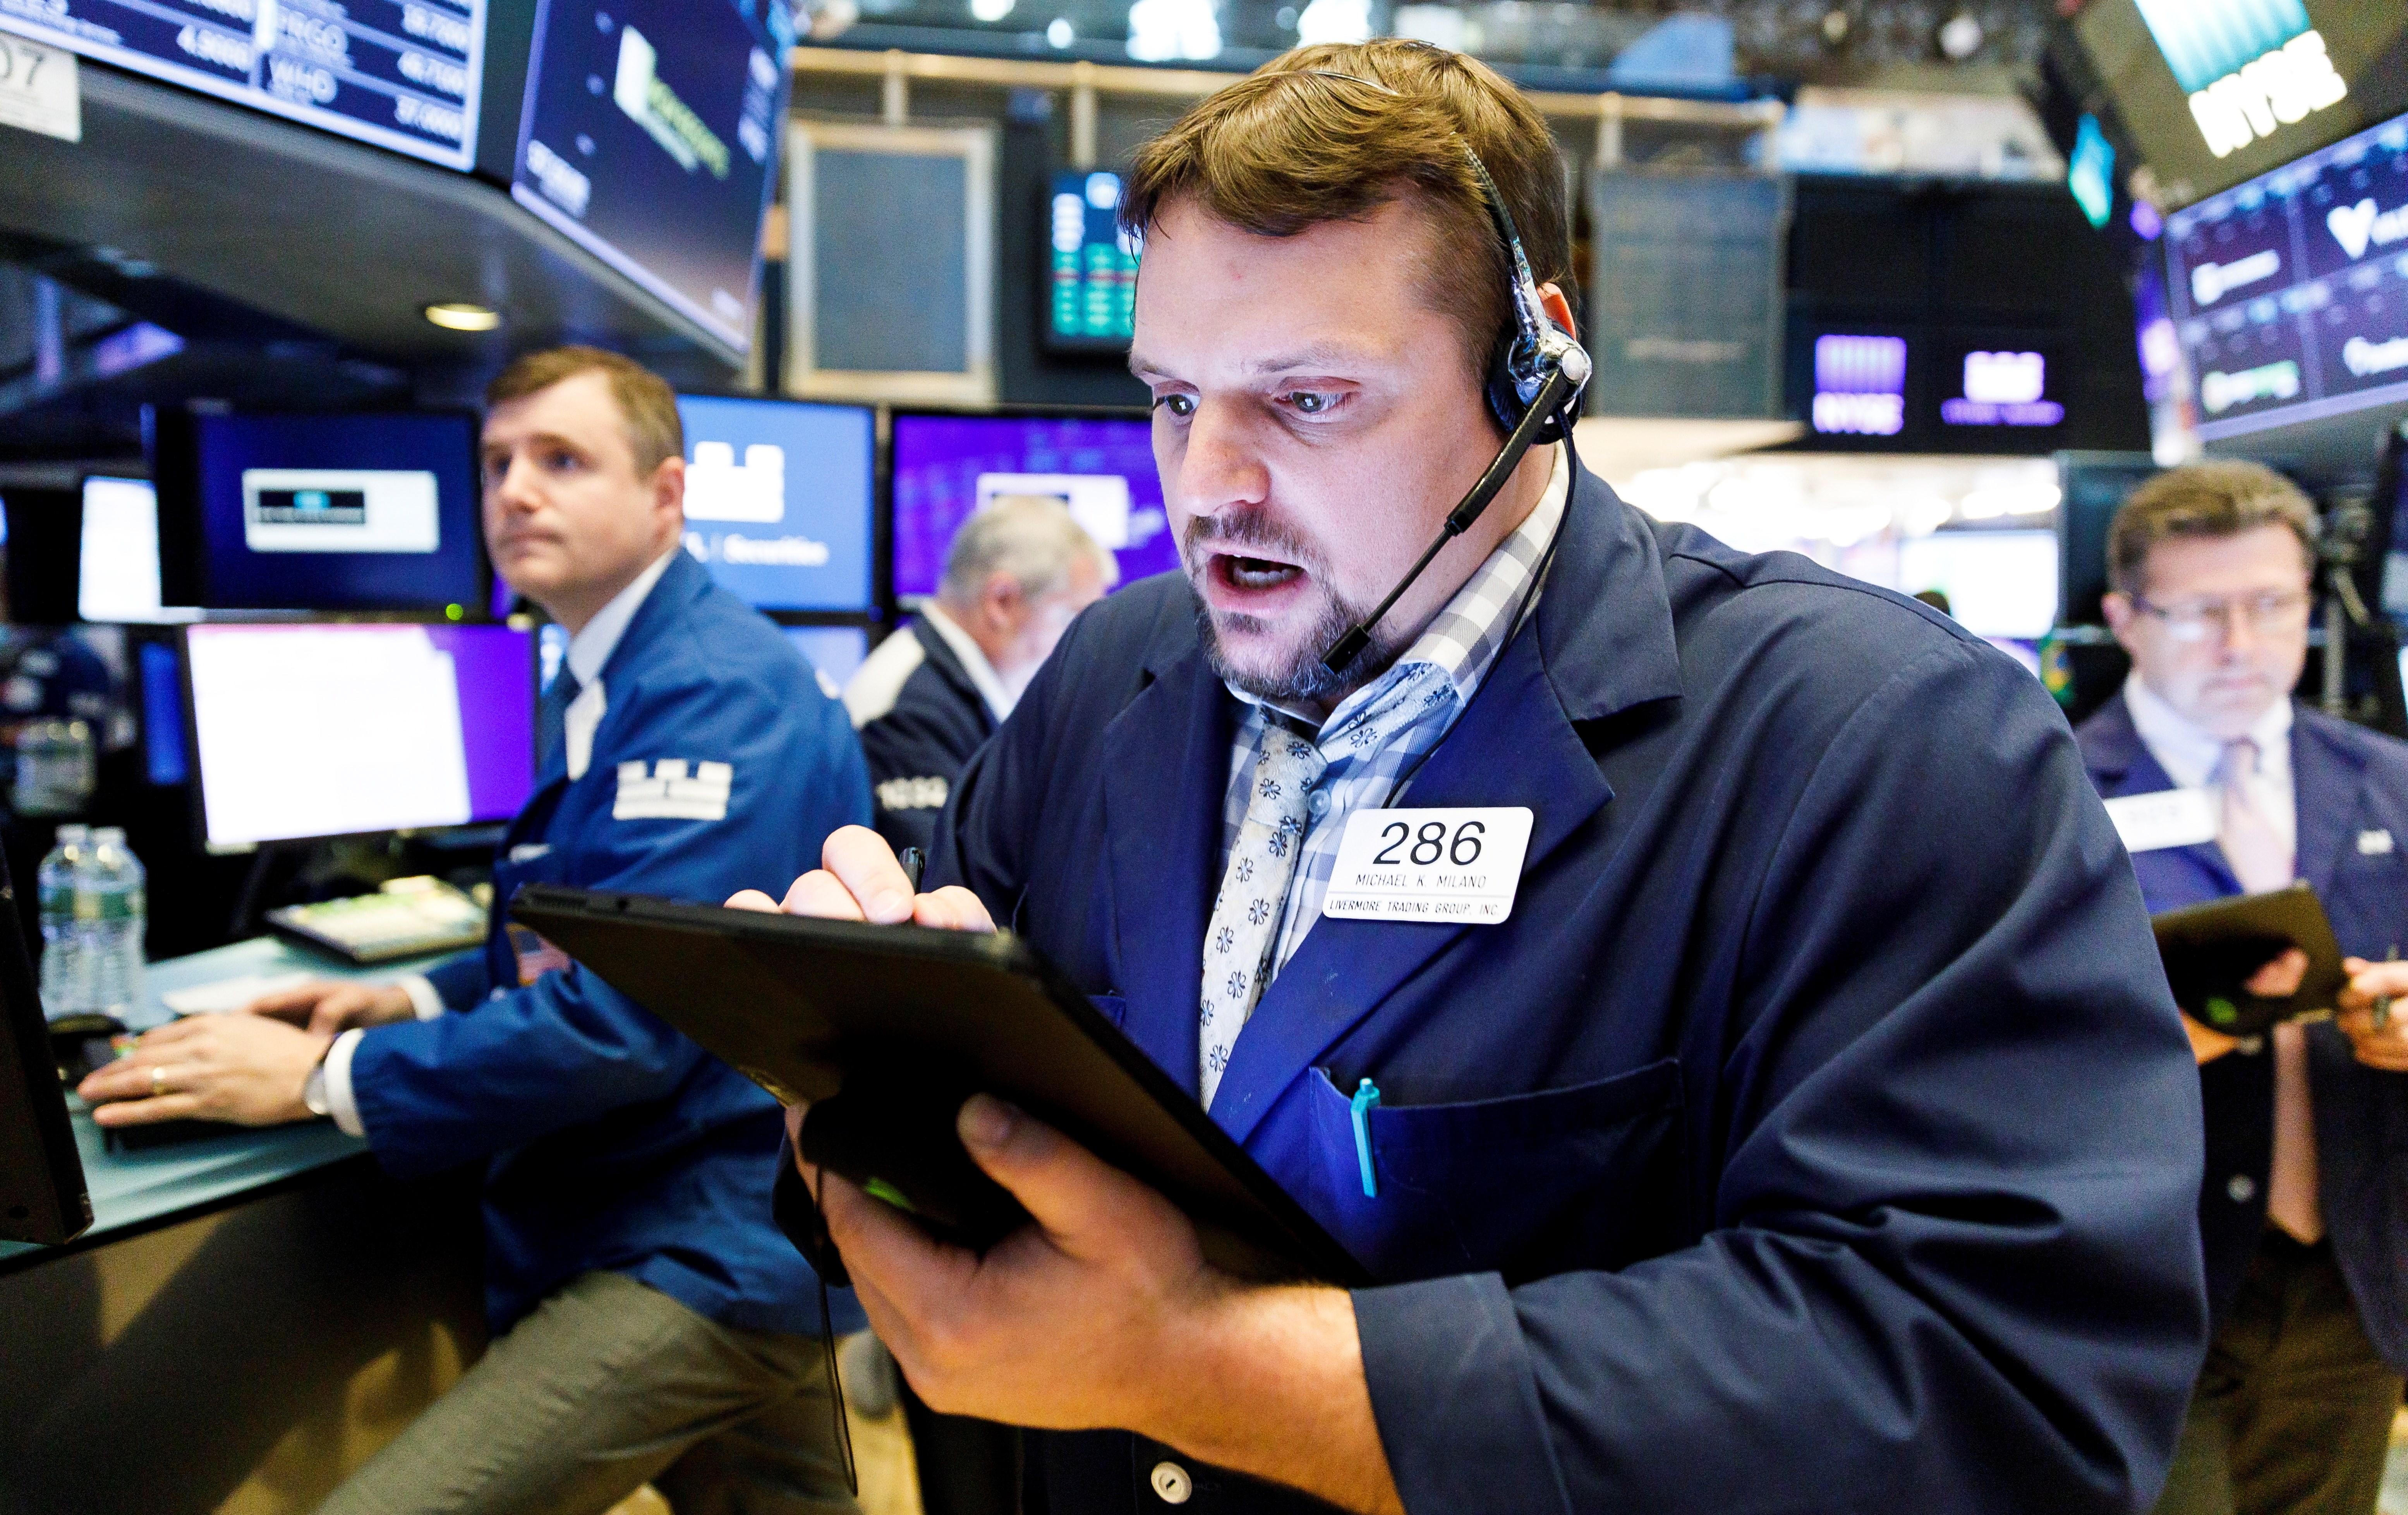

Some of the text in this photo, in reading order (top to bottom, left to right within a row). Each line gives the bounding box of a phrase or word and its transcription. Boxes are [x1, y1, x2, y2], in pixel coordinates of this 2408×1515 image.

[1372, 821, 1485, 866] 286
[1356, 874, 1407, 887] MICHAEL
[1436, 875, 1486, 888] MILANO
[1330, 900, 1382, 911] LIVERMORE
[1387, 902, 1429, 913] TRADING
